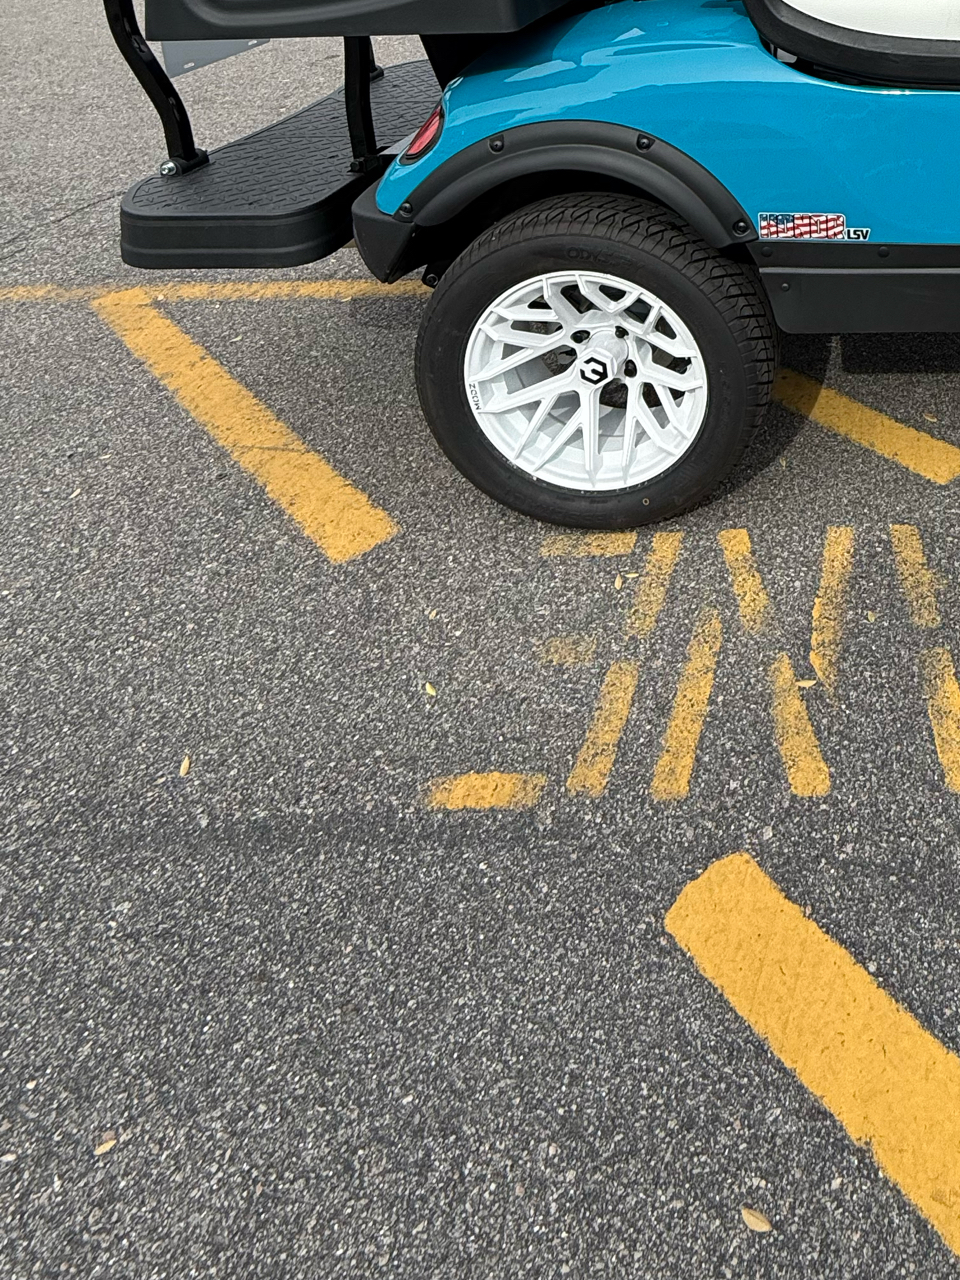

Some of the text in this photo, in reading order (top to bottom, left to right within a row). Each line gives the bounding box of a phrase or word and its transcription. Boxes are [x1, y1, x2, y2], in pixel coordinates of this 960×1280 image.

[758, 213, 870, 240] HONOR LSV
[468, 383, 482, 410] MODZ
